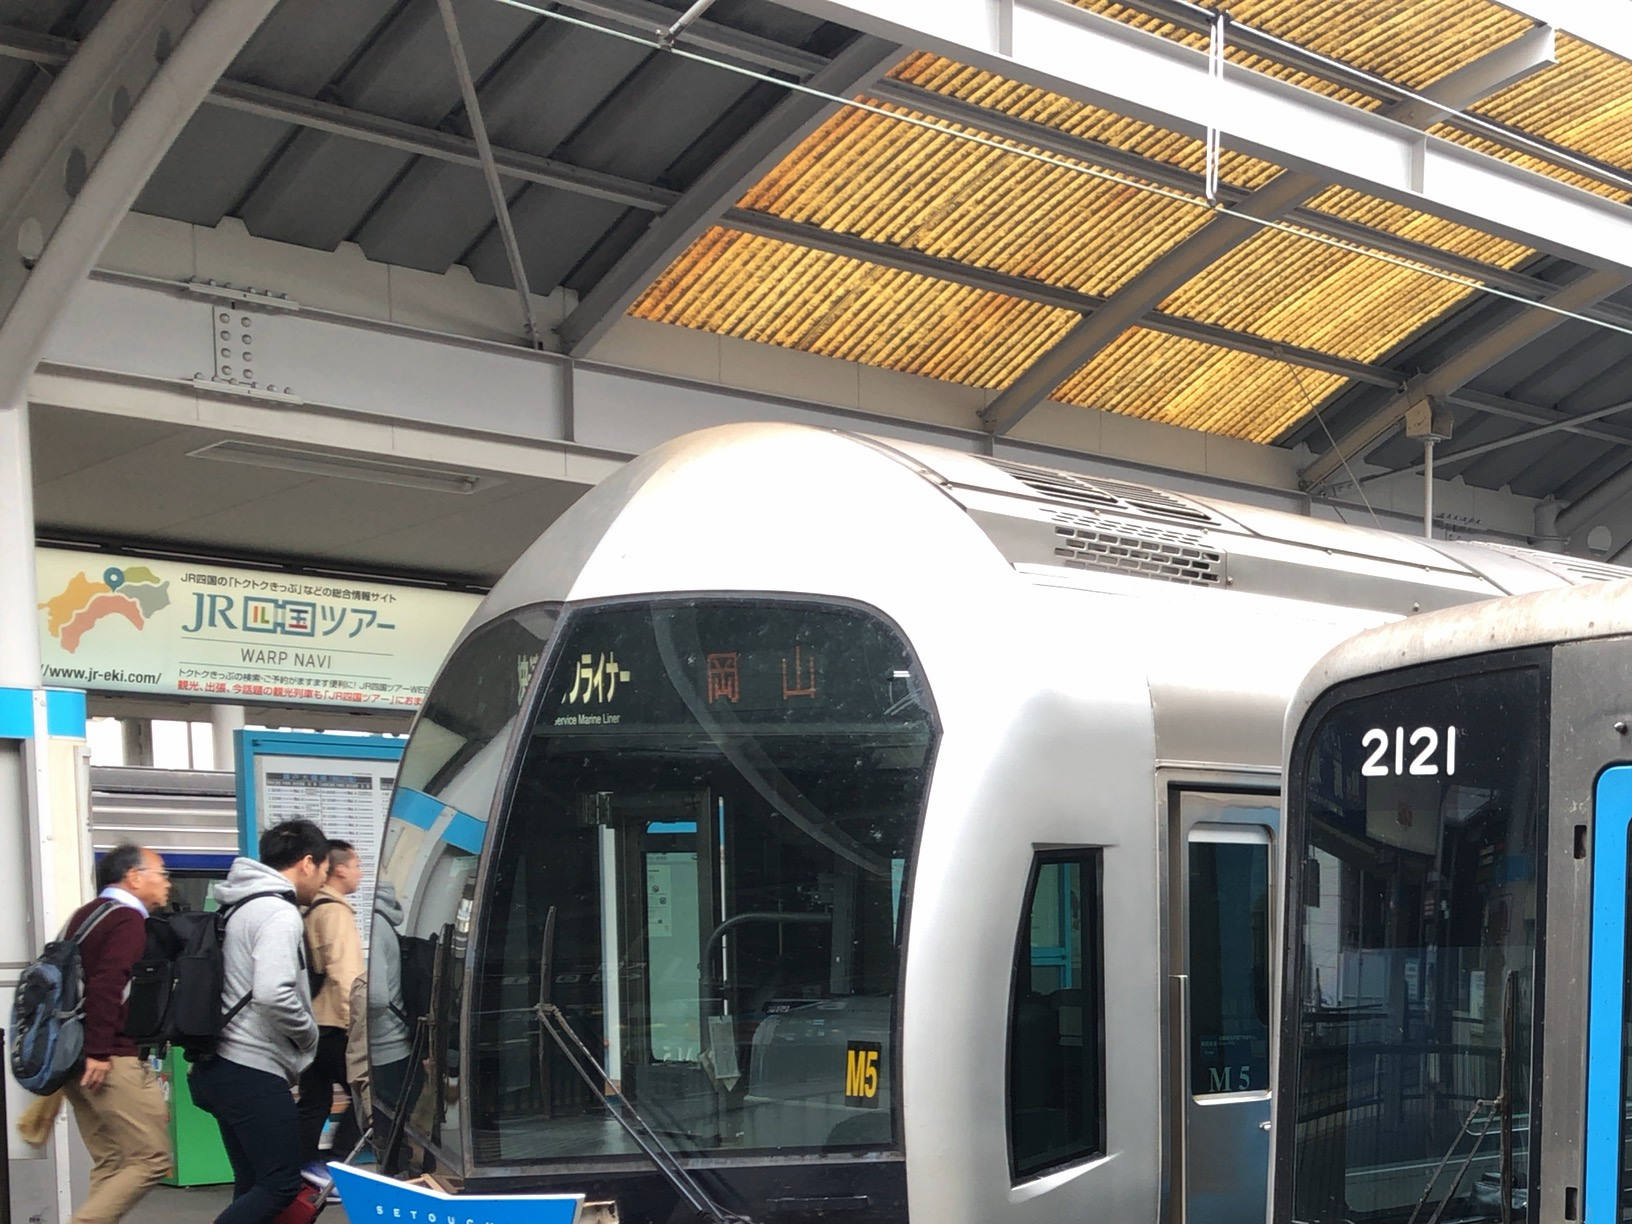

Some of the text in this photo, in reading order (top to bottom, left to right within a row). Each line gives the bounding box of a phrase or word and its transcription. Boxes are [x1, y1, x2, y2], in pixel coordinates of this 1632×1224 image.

[241, 648, 331, 669] WARP NAVI
[578, 714, 602, 725] Marine
[603, 713, 621, 724] Liner
[1361, 726, 1456, 777] 2121
[846, 1050, 879, 1098] M5
